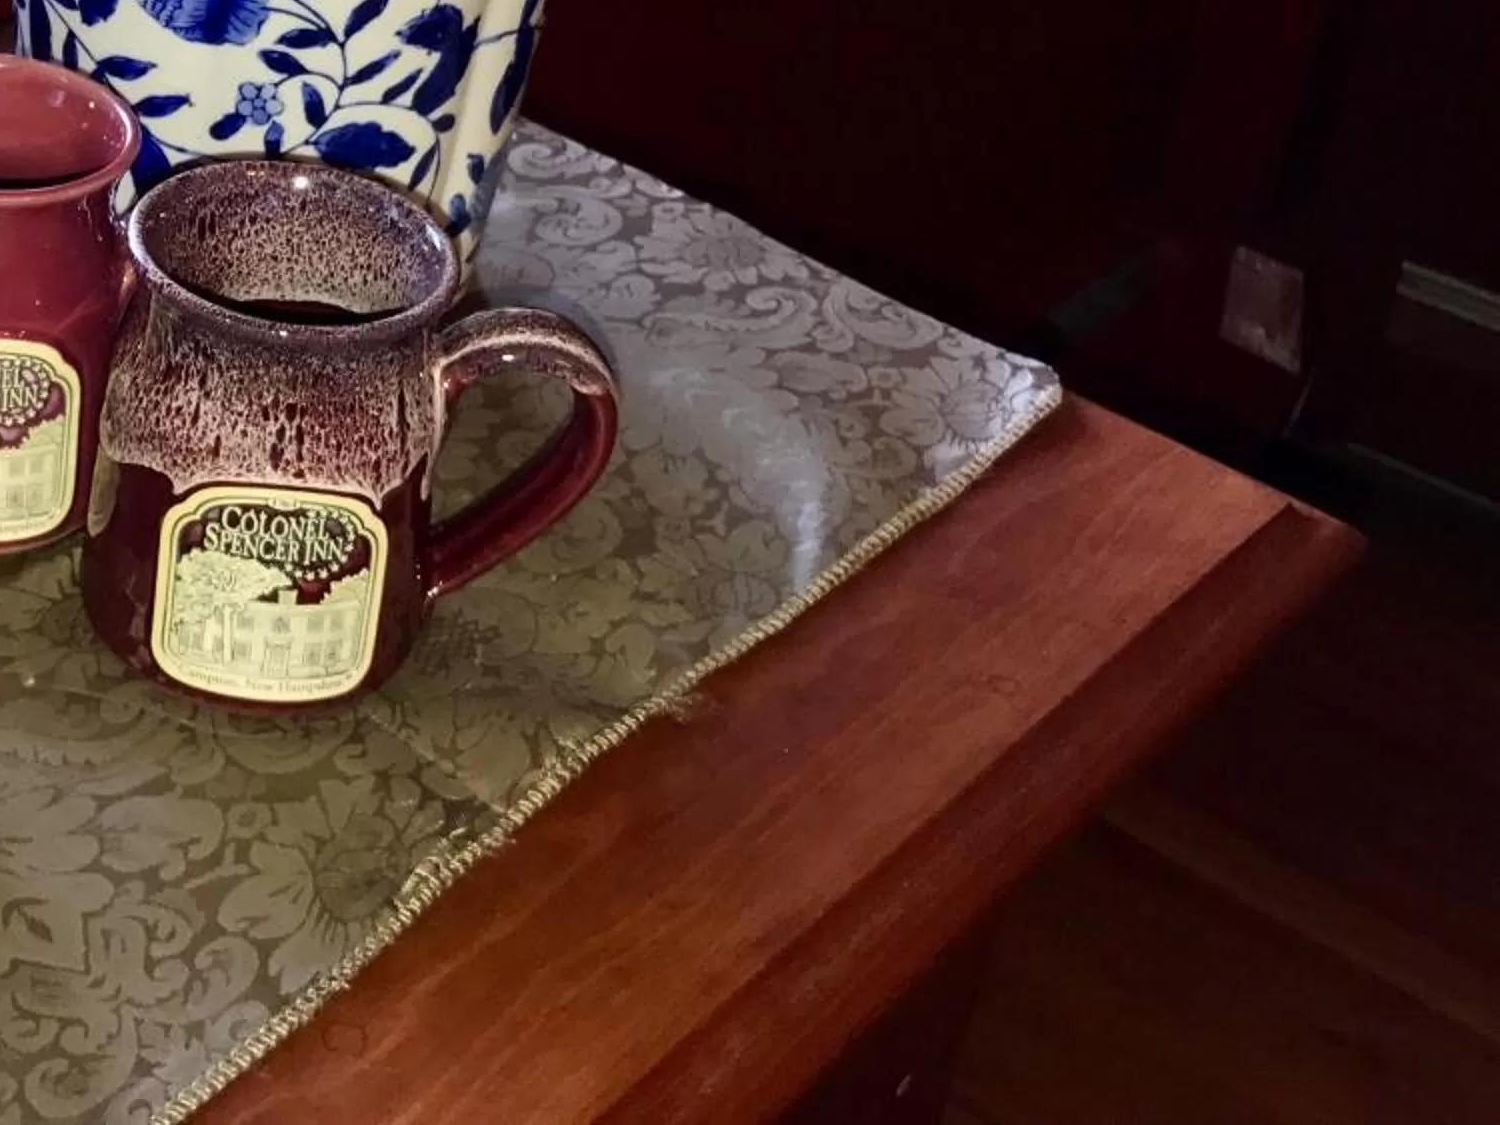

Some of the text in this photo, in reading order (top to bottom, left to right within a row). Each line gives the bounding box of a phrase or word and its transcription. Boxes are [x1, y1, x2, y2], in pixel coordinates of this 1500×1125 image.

[1, 384, 39, 411] INN
[222, 506, 329, 540] COLONEL
[203, 522, 343, 565] SPENCER INN
